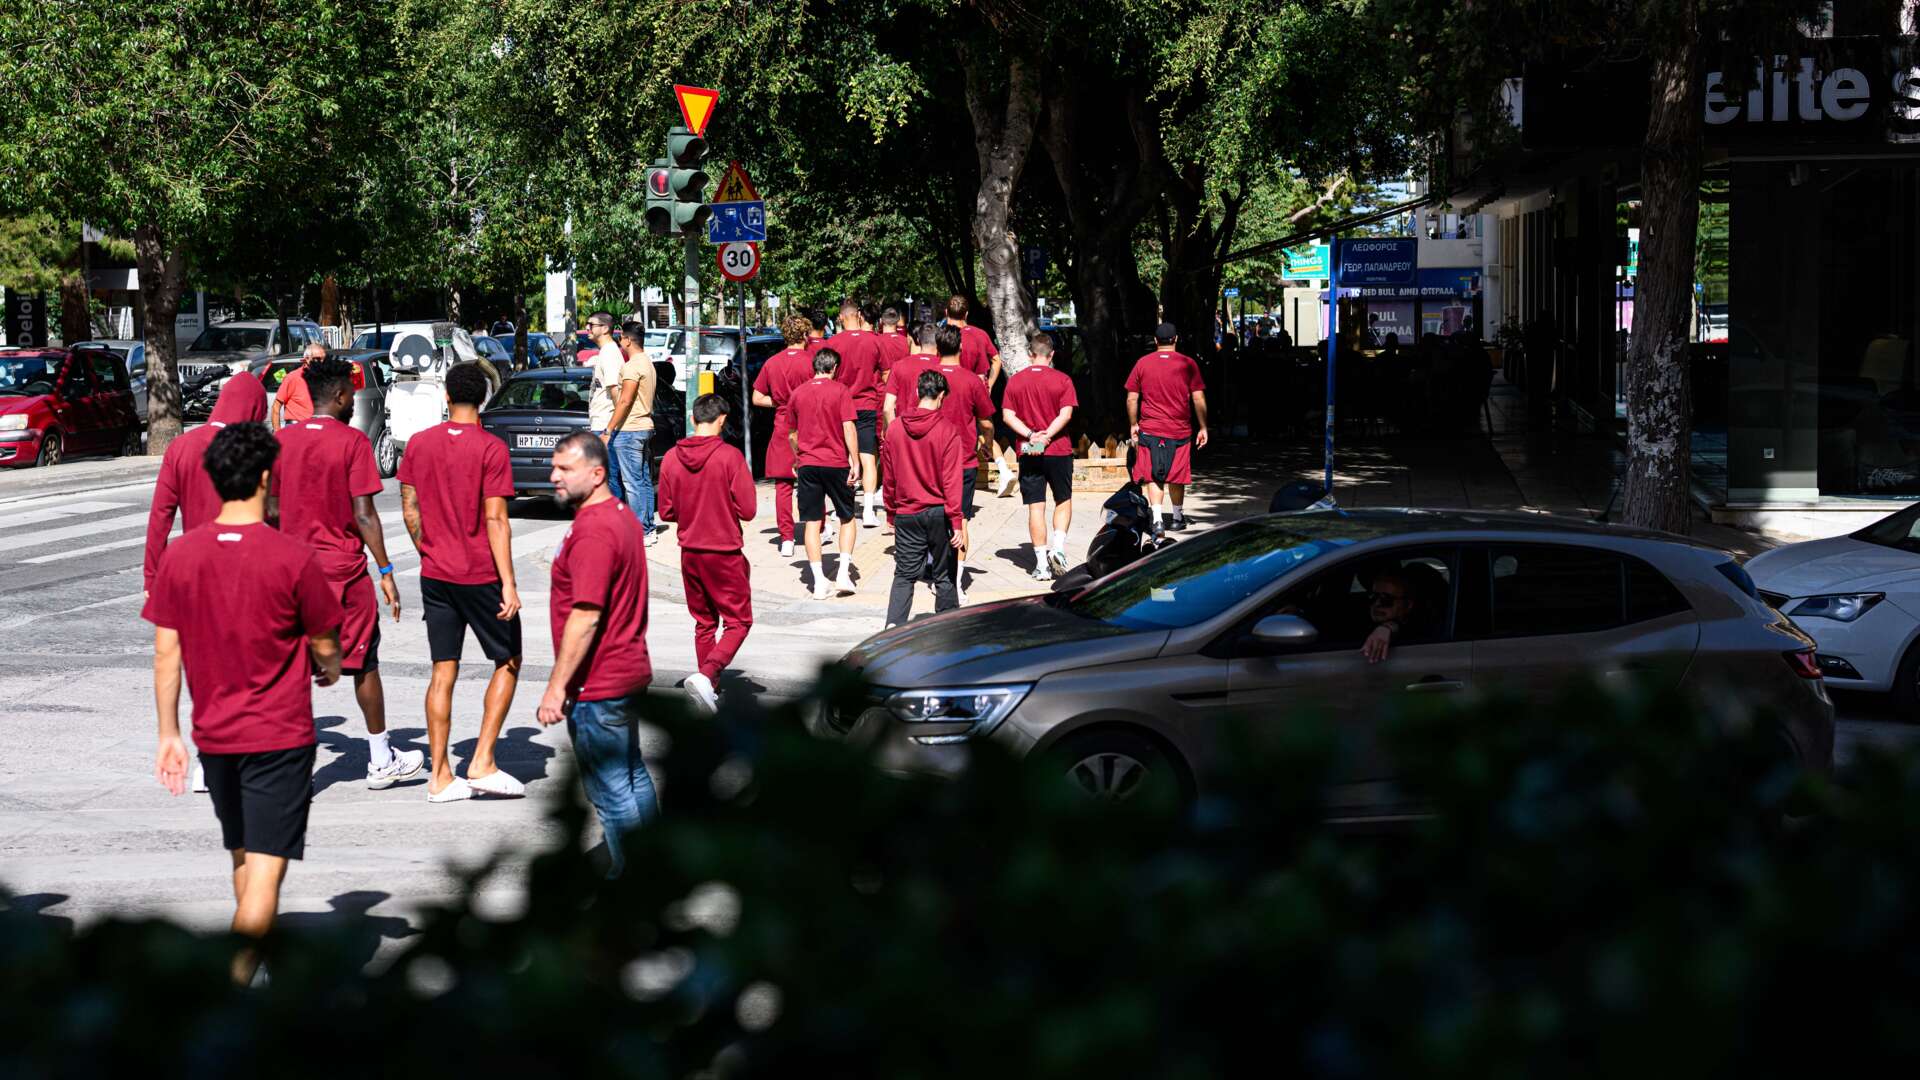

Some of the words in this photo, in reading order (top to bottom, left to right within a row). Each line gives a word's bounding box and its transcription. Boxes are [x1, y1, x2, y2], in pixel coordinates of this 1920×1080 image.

[1704, 54, 1871, 125] elite
[1352, 243, 1398, 252] ΛΕΩΦΟΡΟΣ
[727, 250, 751, 268] 30
[1364, 261, 1412, 272] ΠΑΠΑΝΔΡΕΟΥ
[1363, 288, 1377, 297] RED
[1378, 288, 1396, 297] BULL
